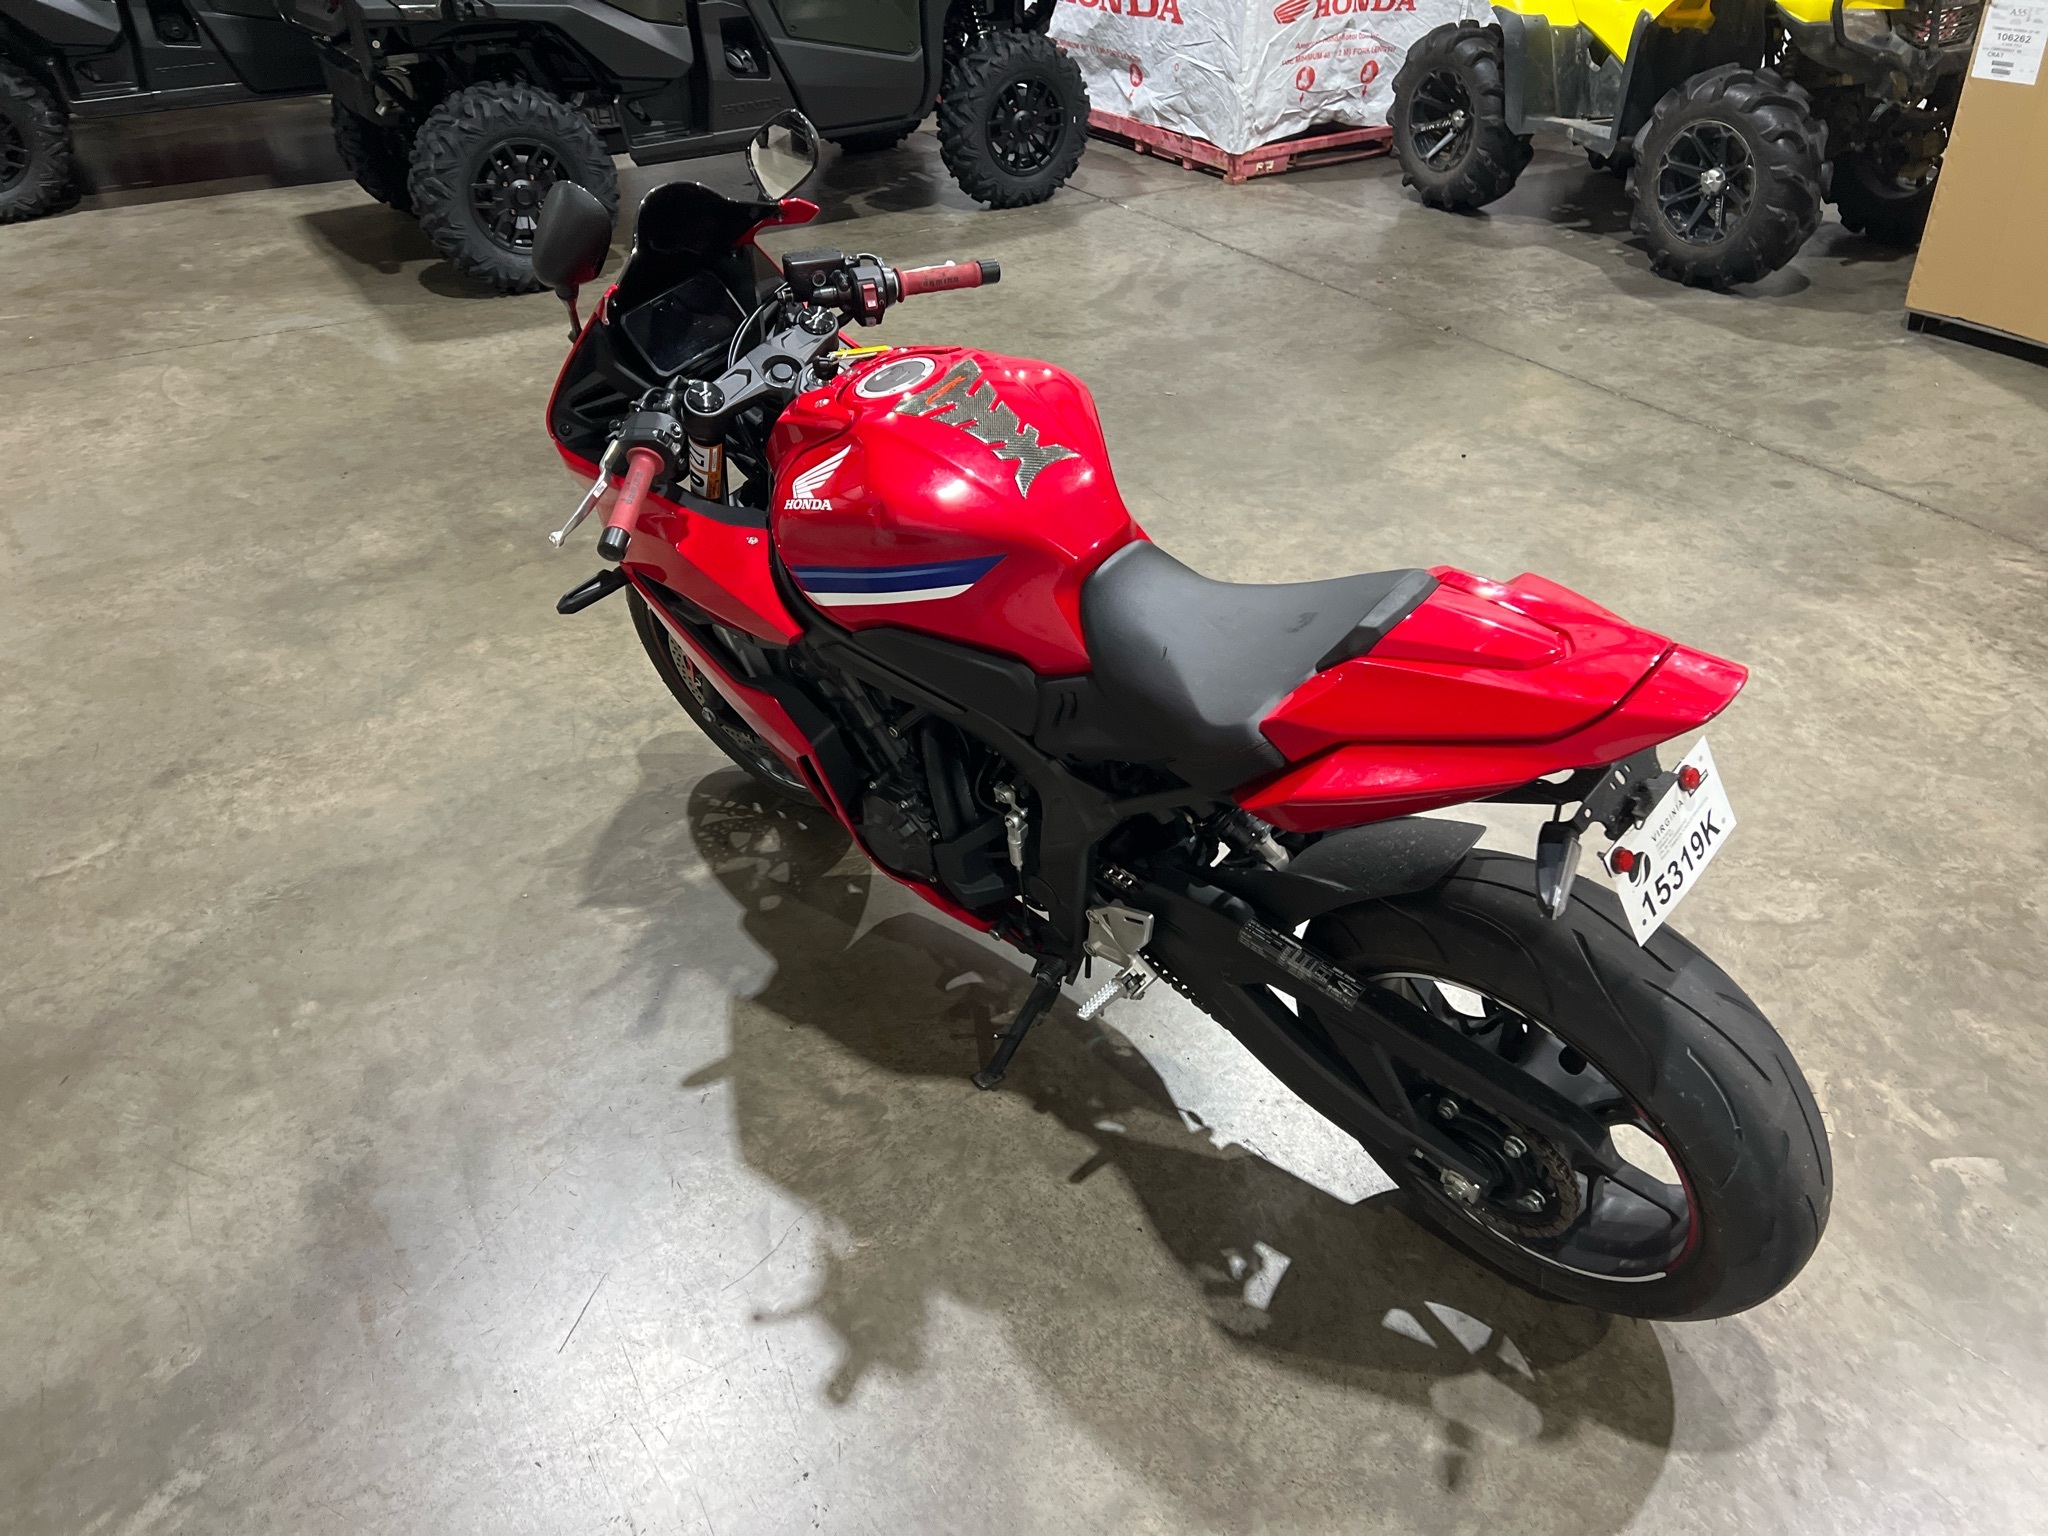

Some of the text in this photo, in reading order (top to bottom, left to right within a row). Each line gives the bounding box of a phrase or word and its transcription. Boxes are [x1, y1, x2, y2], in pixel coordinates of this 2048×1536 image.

[1065, 0, 1184, 25] NDA
[1997, 32, 2032, 44] 106262
[784, 499, 833, 511] HONDA
[1651, 800, 1684, 842] VIRGINIA
[1642, 808, 1721, 917] 15319K
